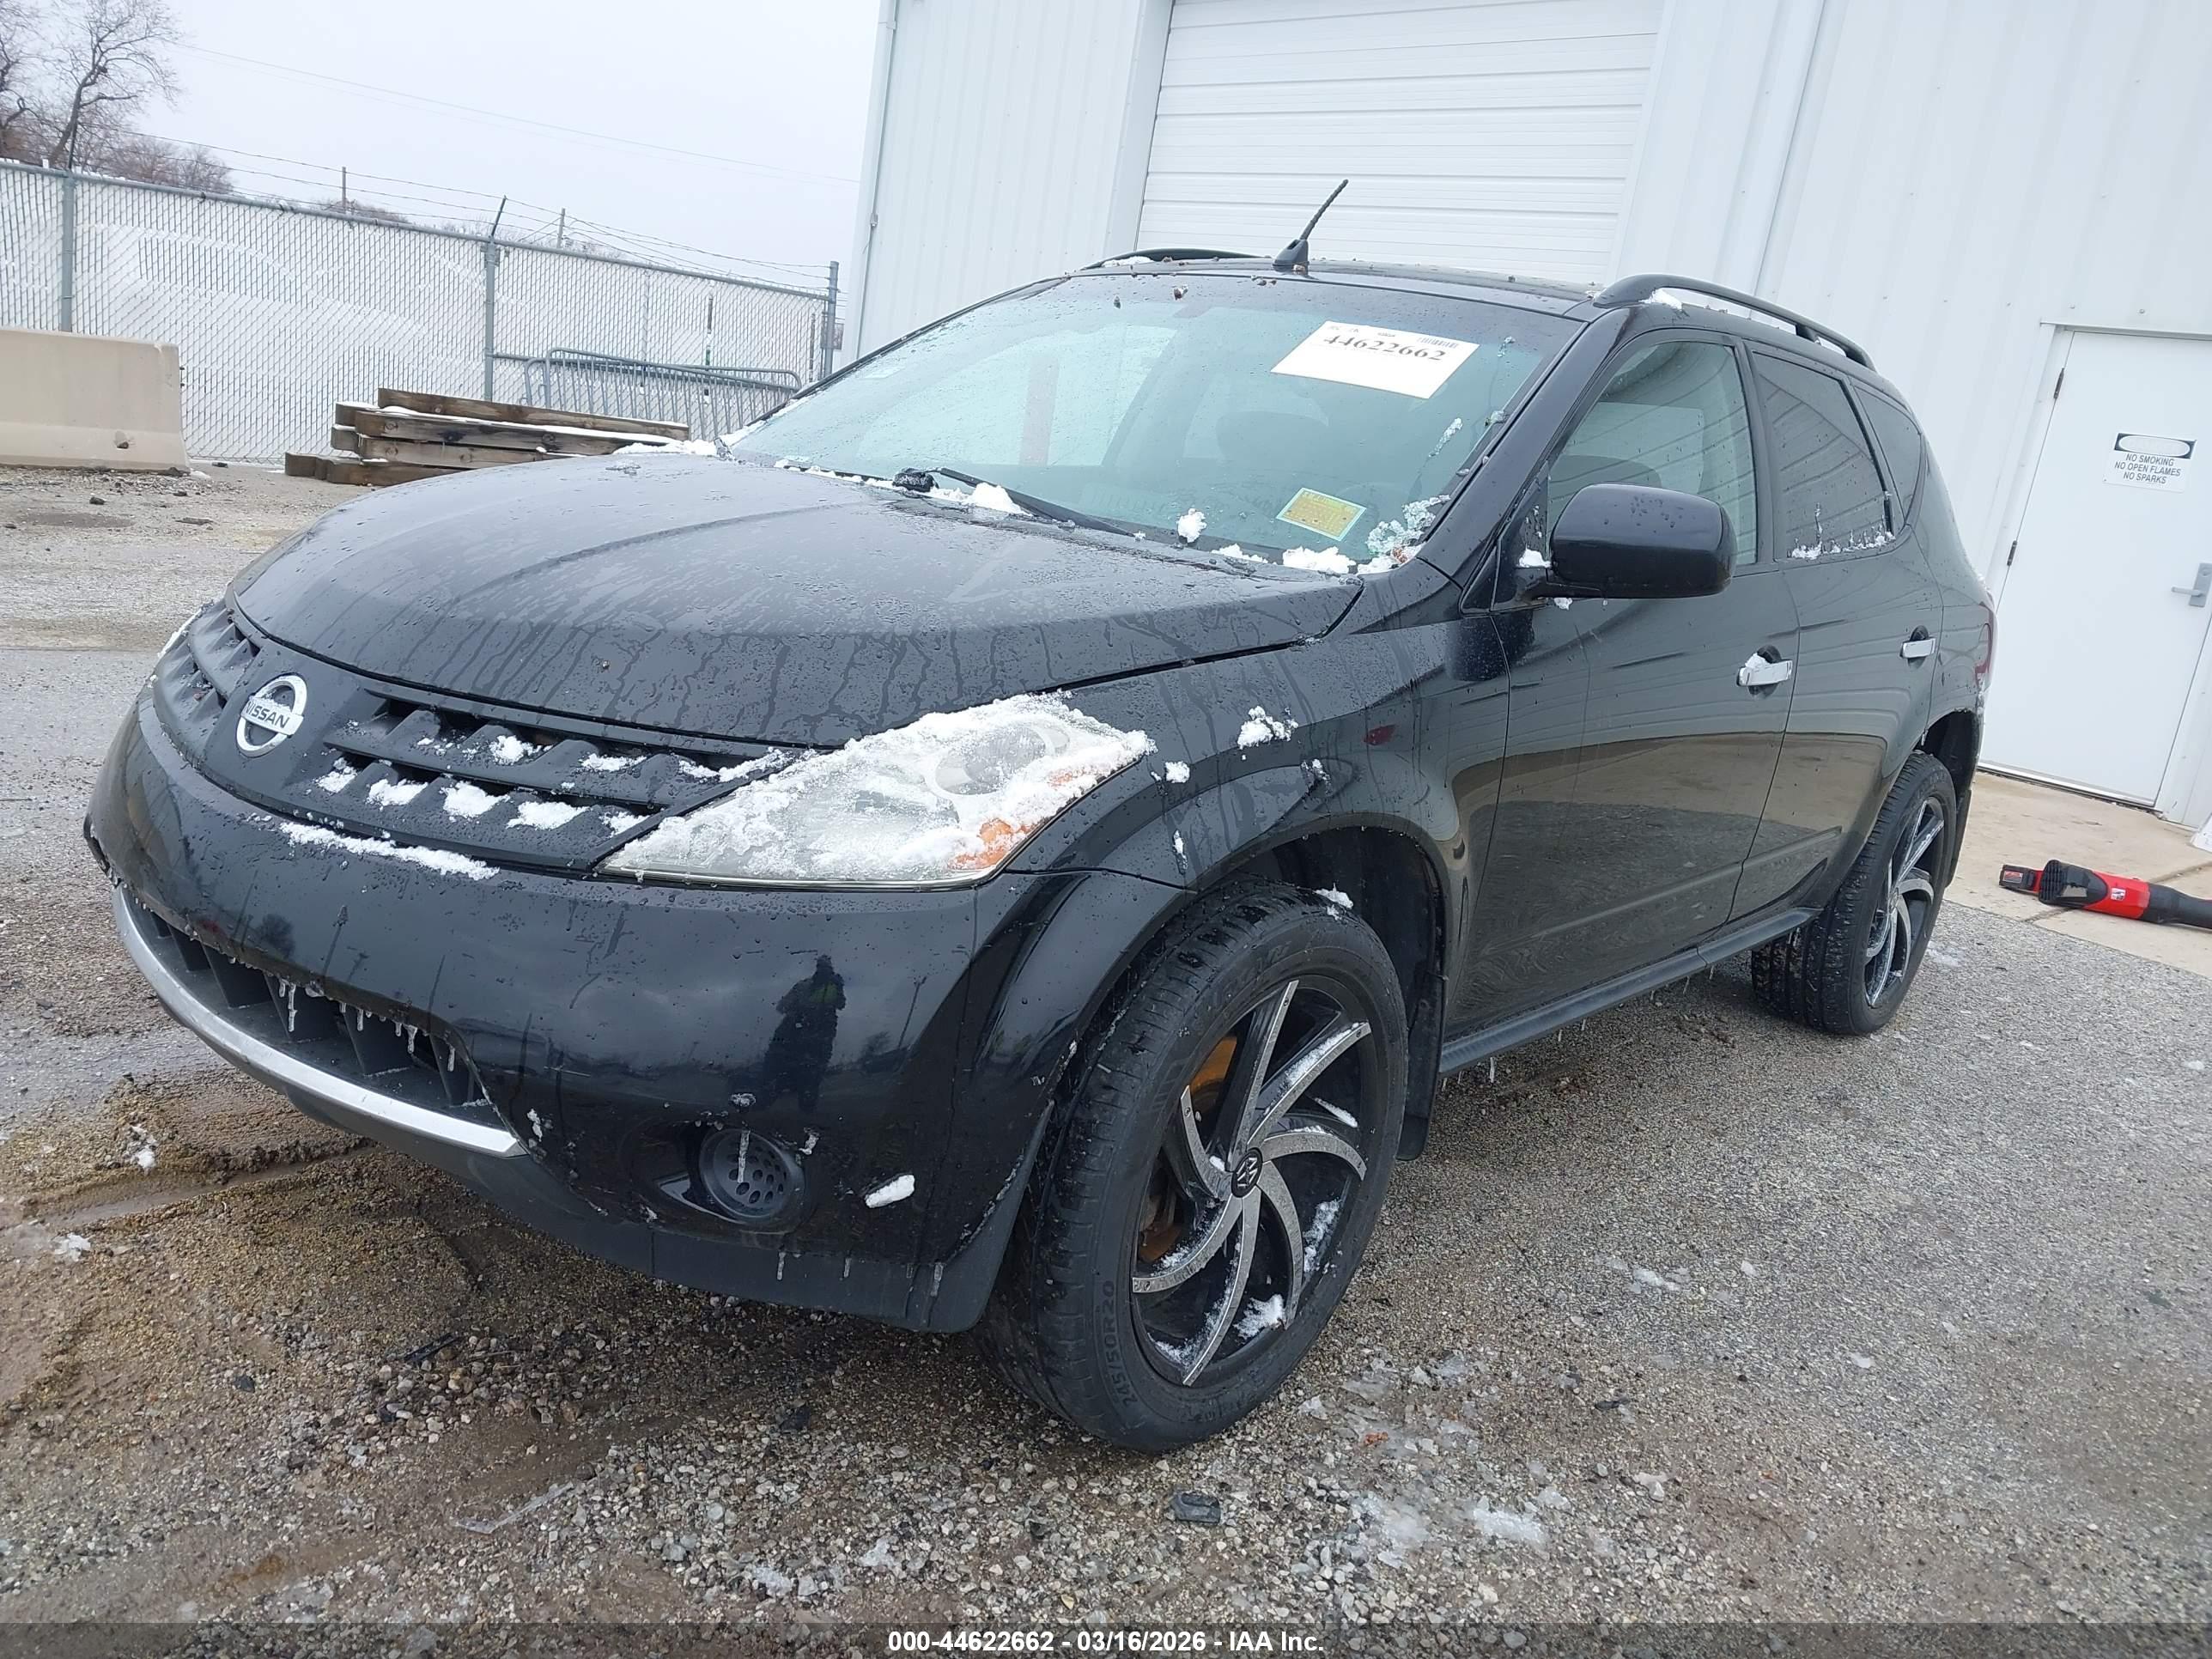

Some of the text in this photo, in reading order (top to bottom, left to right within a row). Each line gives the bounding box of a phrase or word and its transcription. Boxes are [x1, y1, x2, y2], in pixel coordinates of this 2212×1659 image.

[1323, 335, 1446, 361] 44622662
[2125, 453, 2175, 467] NO SMOKING
[2114, 461, 2181, 477] NO OPEN FLAMES
[2123, 471, 2136, 481] NO
[2136, 473, 2167, 484] SPARKS
[244, 700, 290, 729] NISSAN
